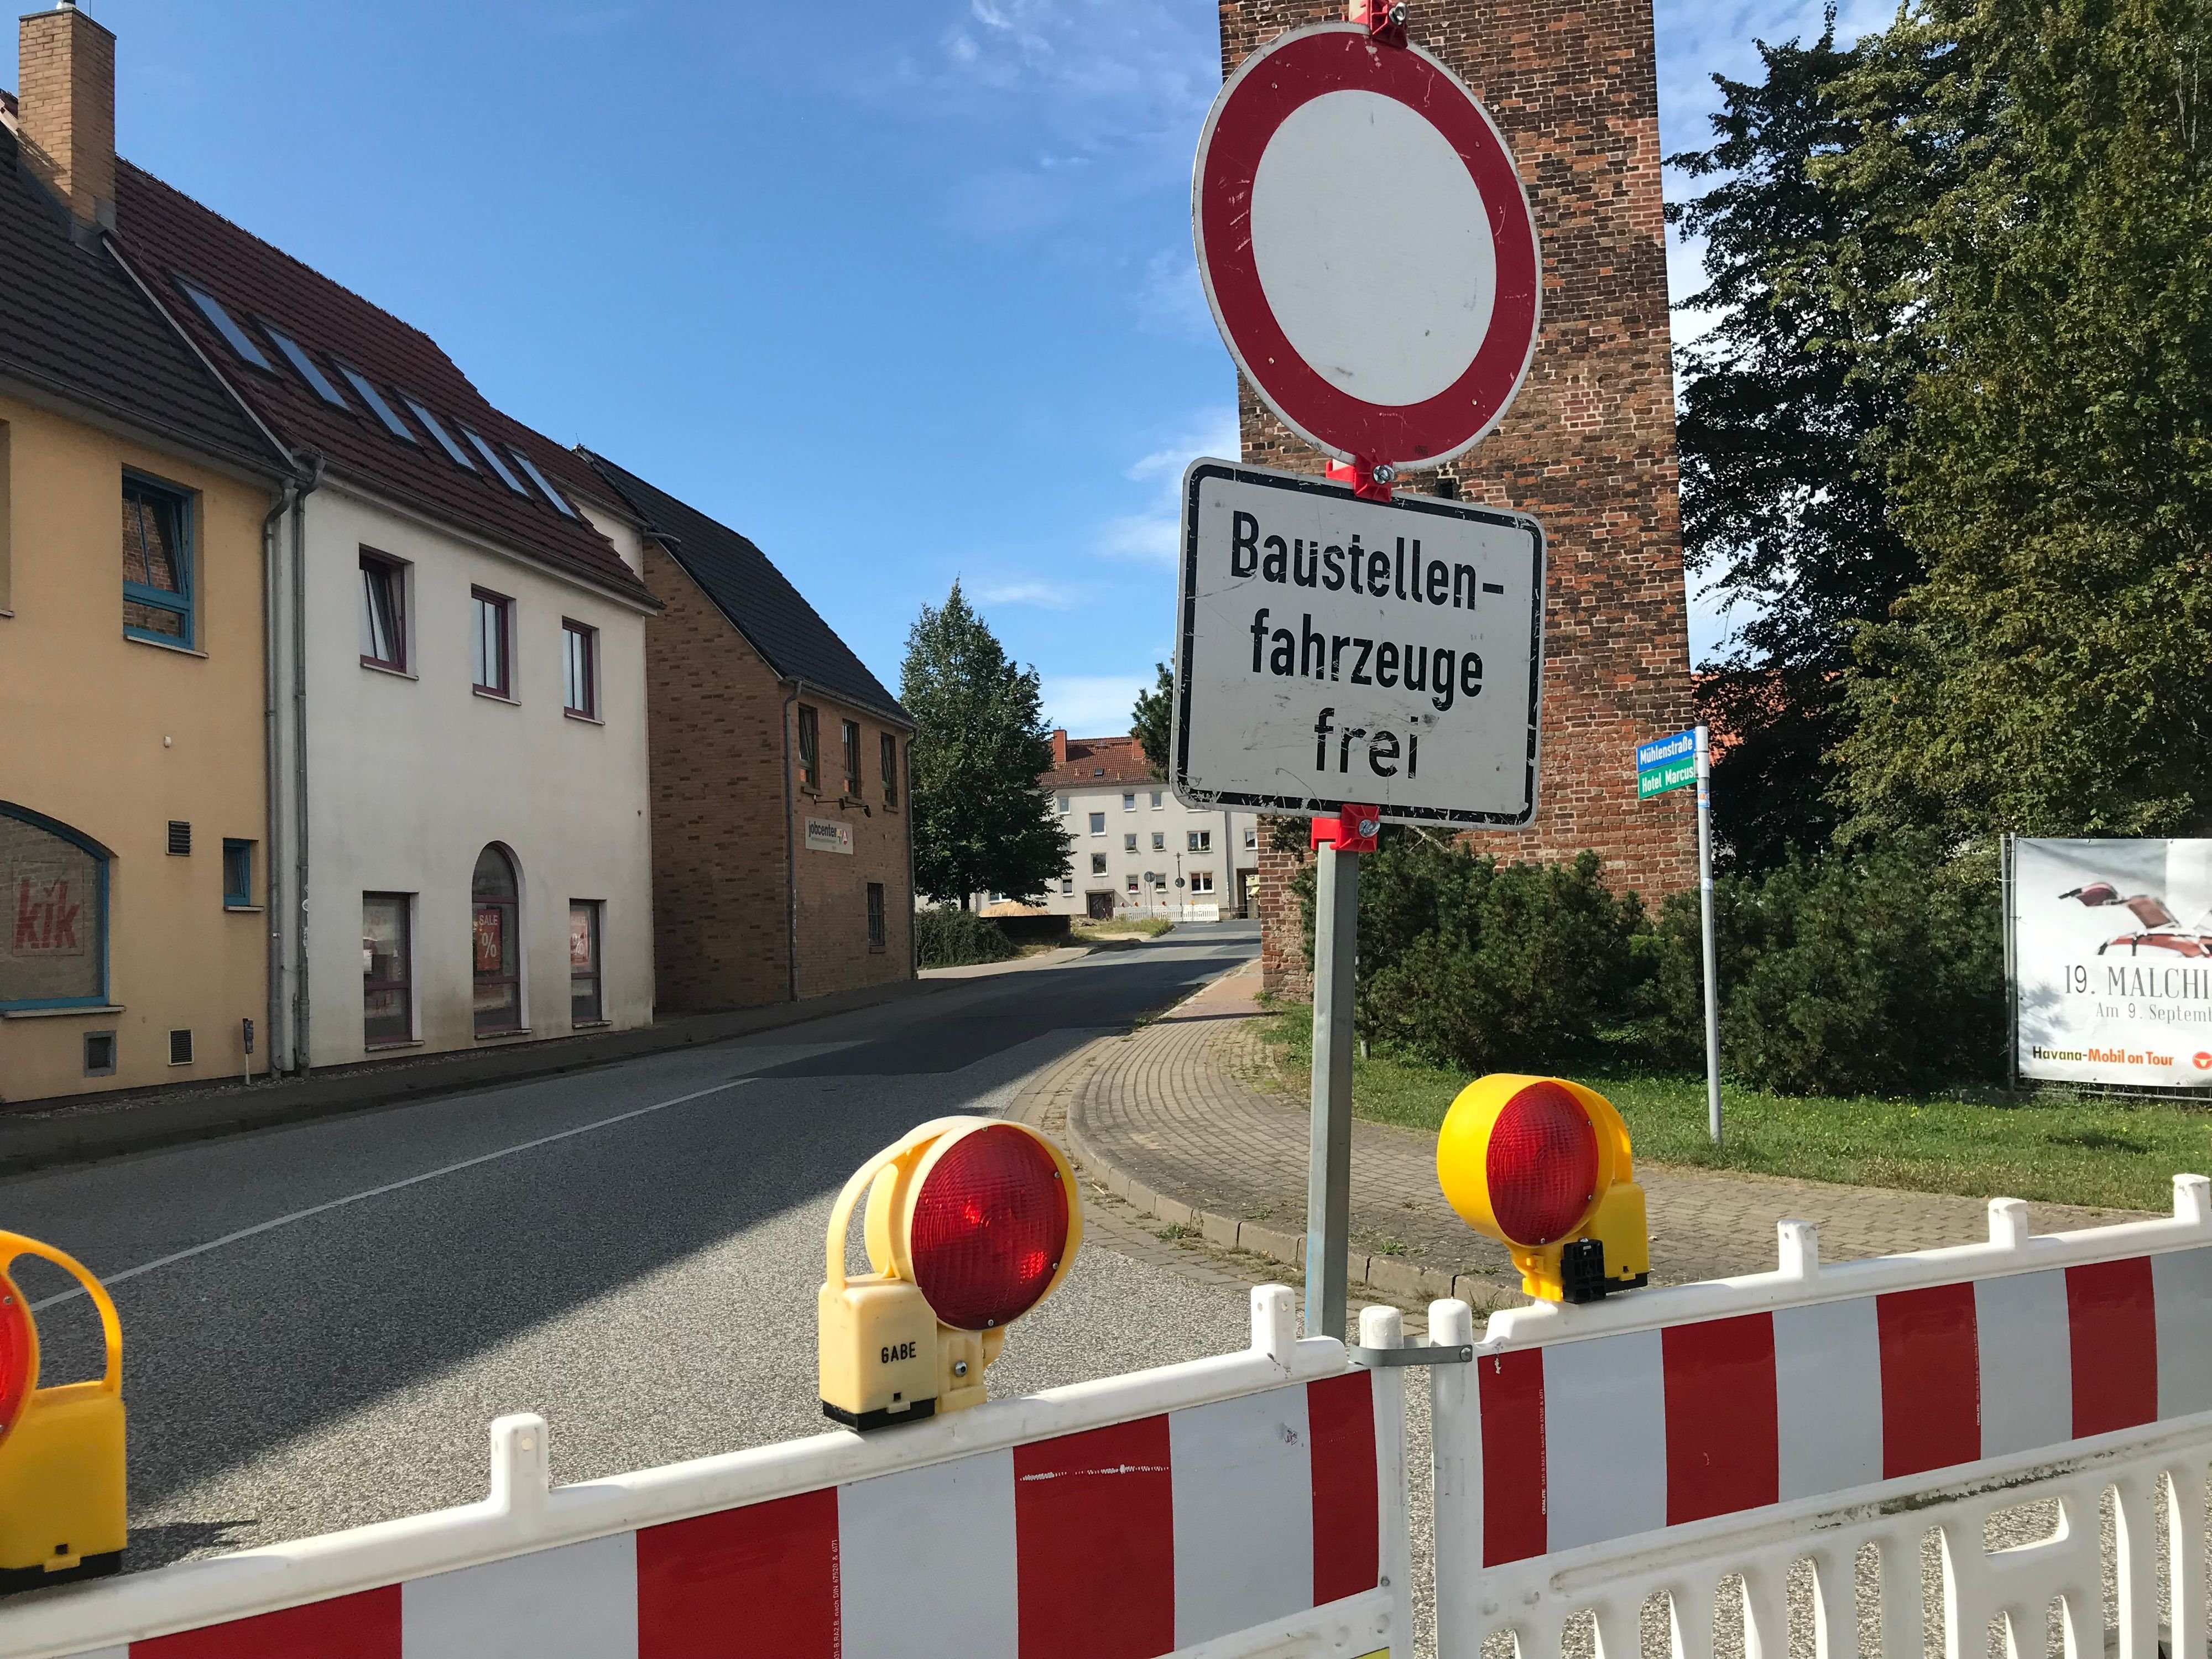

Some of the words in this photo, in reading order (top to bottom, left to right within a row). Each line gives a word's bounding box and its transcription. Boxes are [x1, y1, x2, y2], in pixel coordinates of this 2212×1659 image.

[1231, 510, 1504, 610] Baustellen-
[1250, 608, 1483, 712] fahrzeuge
[1314, 707, 1419, 779] frei
[1640, 736, 1692, 765] Mühlenstraße
[1642, 773, 1662, 793] Hotel
[1665, 766, 1693, 786] Marcus
[808, 821, 837, 837] jobcenter
[479, 915, 498, 925] SALE
[482, 932, 497, 958] %
[2065, 965, 2095, 994] 19.
[2107, 966, 2209, 999] MALCHI
[2096, 1002, 2119, 1018] Am
[2128, 1003, 2142, 1019] 9.
[2033, 1046, 2125, 1063] Havana-Mobil
[2128, 1053, 2143, 1064] on
[2146, 1051, 2174, 1066] Tour
[881, 1341, 916, 1364] GABE
